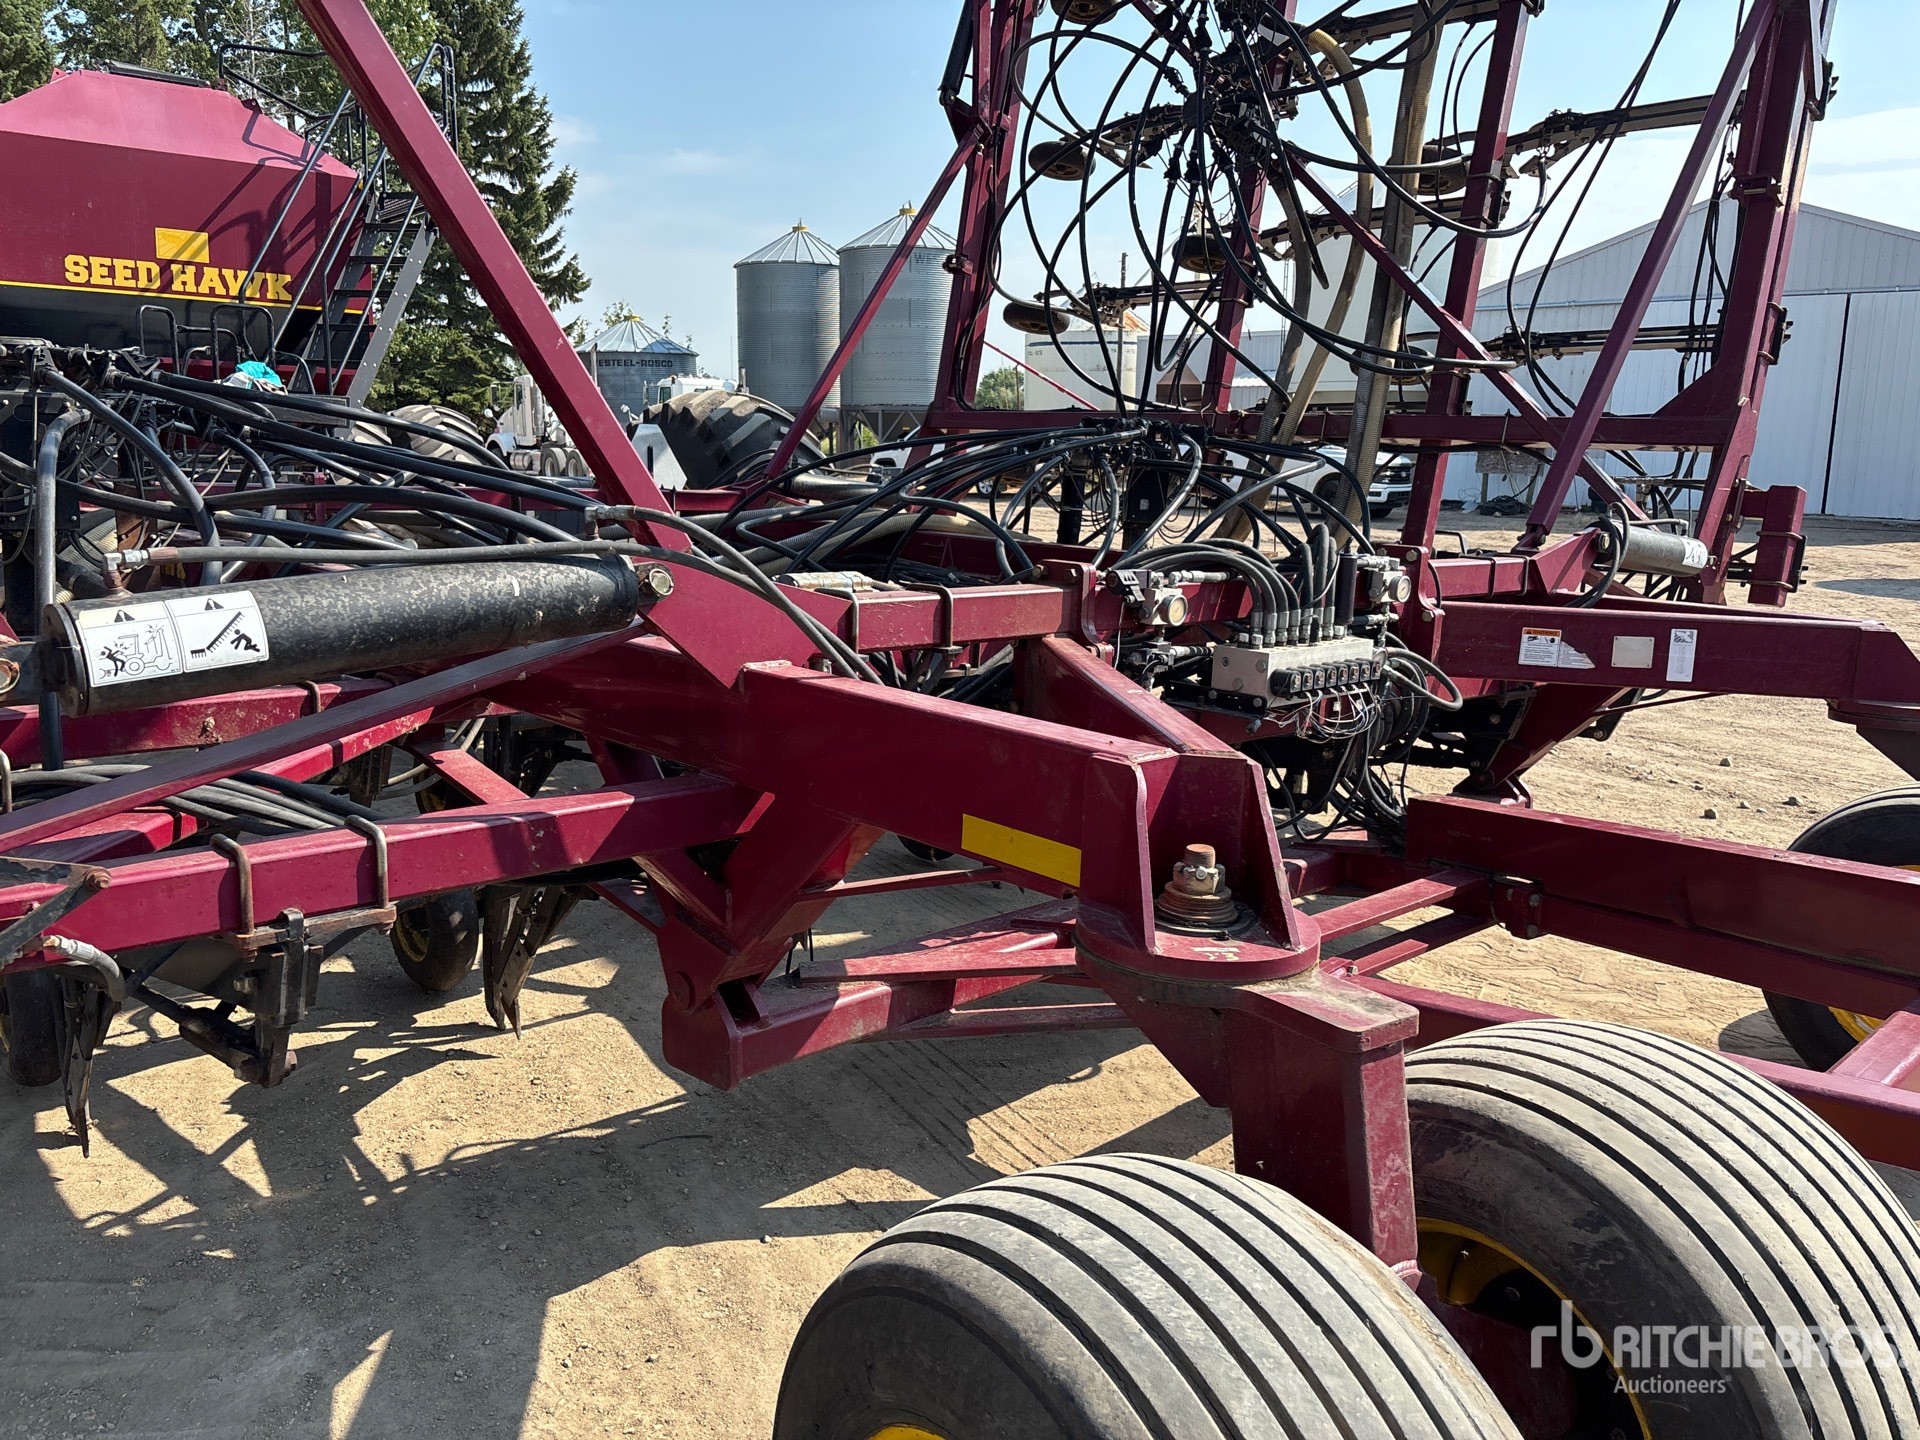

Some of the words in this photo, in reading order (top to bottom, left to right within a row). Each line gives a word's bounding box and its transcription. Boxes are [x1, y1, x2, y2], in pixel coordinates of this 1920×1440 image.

[64, 254, 161, 290] SEED
[171, 263, 293, 301] HAWK
[597, 358, 674, 368] ESTEEL-ROSCO
